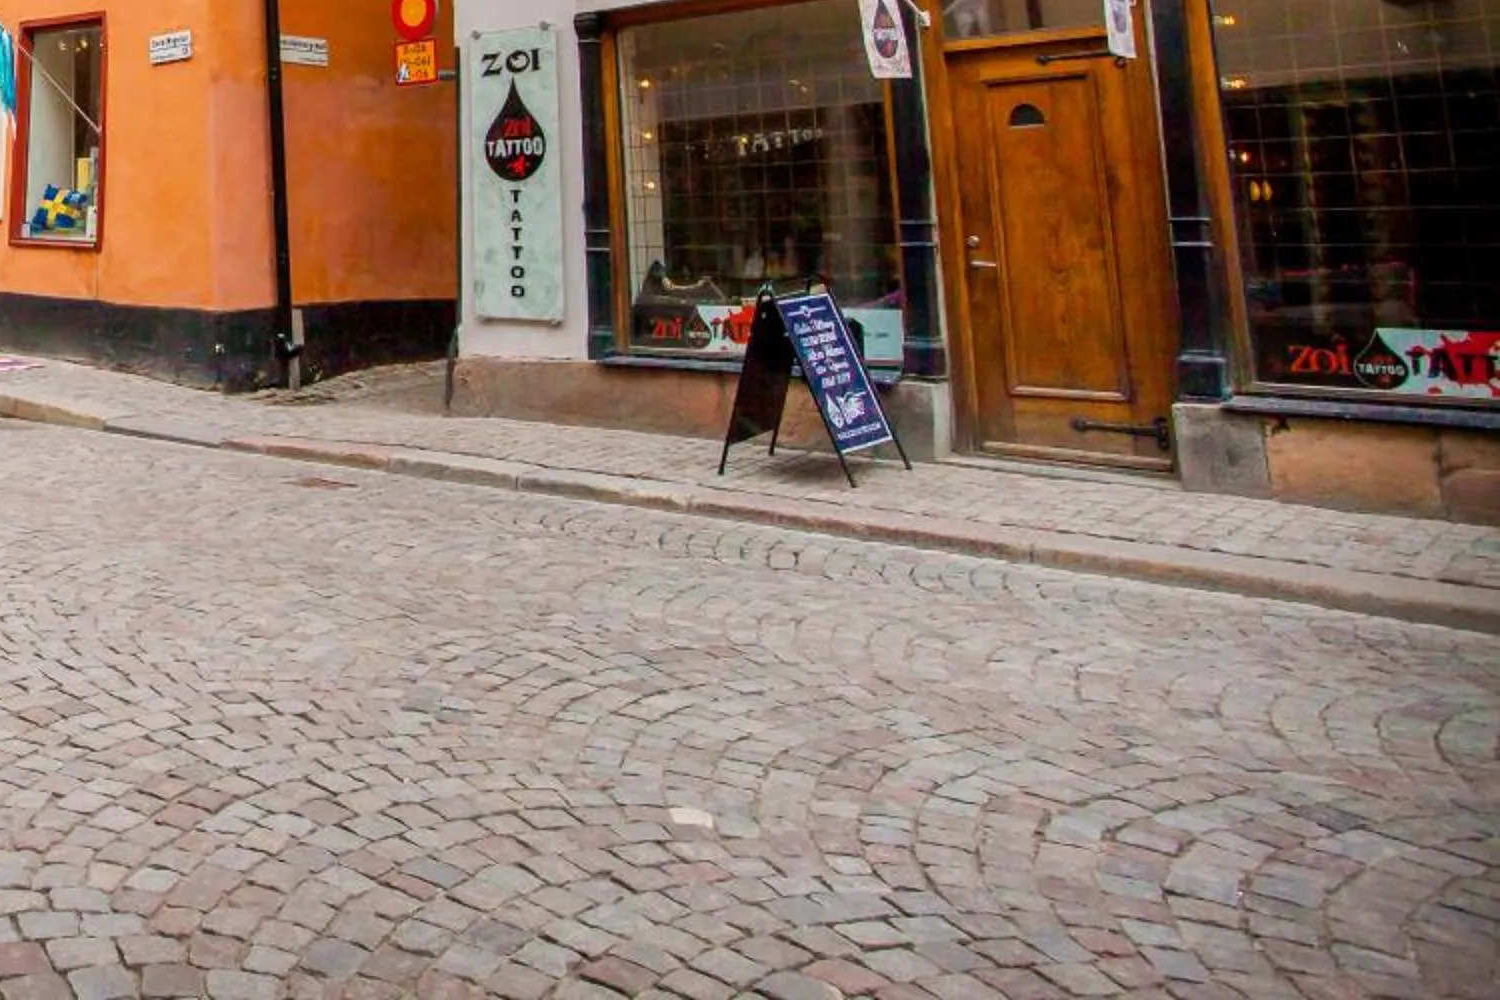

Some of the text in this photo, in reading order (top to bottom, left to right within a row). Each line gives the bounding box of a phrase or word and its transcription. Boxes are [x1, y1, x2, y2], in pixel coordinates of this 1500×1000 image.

[481, 48, 541, 78] ZOI
[487, 136, 543, 158] TATTOO
[1358, 363, 1405, 377] TATTOO
